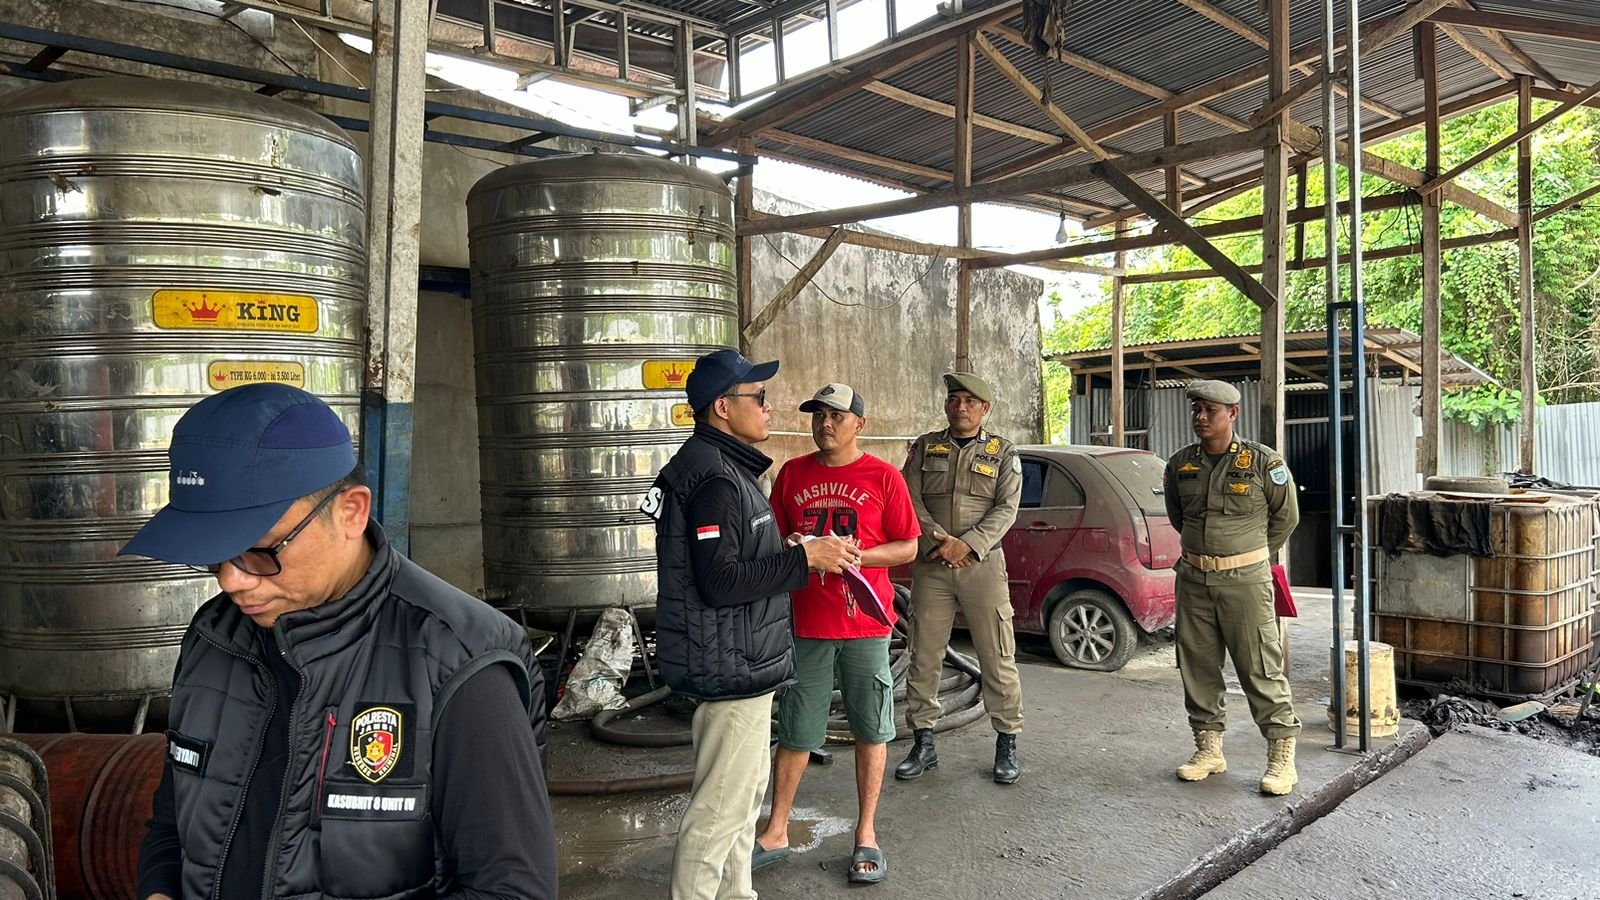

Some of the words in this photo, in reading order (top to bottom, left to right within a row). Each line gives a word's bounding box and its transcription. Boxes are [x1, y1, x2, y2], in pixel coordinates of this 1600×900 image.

[236, 301, 300, 322] KING
[230, 371, 244, 381] TYPE
[244, 371, 253, 381] KG
[253, 371, 267, 381] 6.000
[277, 371, 290, 381] 5.500
[1226, 471, 1241, 479] POL
[1244, 472, 1255, 480] PP
[794, 482, 869, 506] NASHVILLE
[355, 710, 398, 732] POLRESTA
[359, 723, 393, 735] JAMBI
[327, 793, 374, 810] KASUBNIT
[381, 797, 404, 811] UNIT
